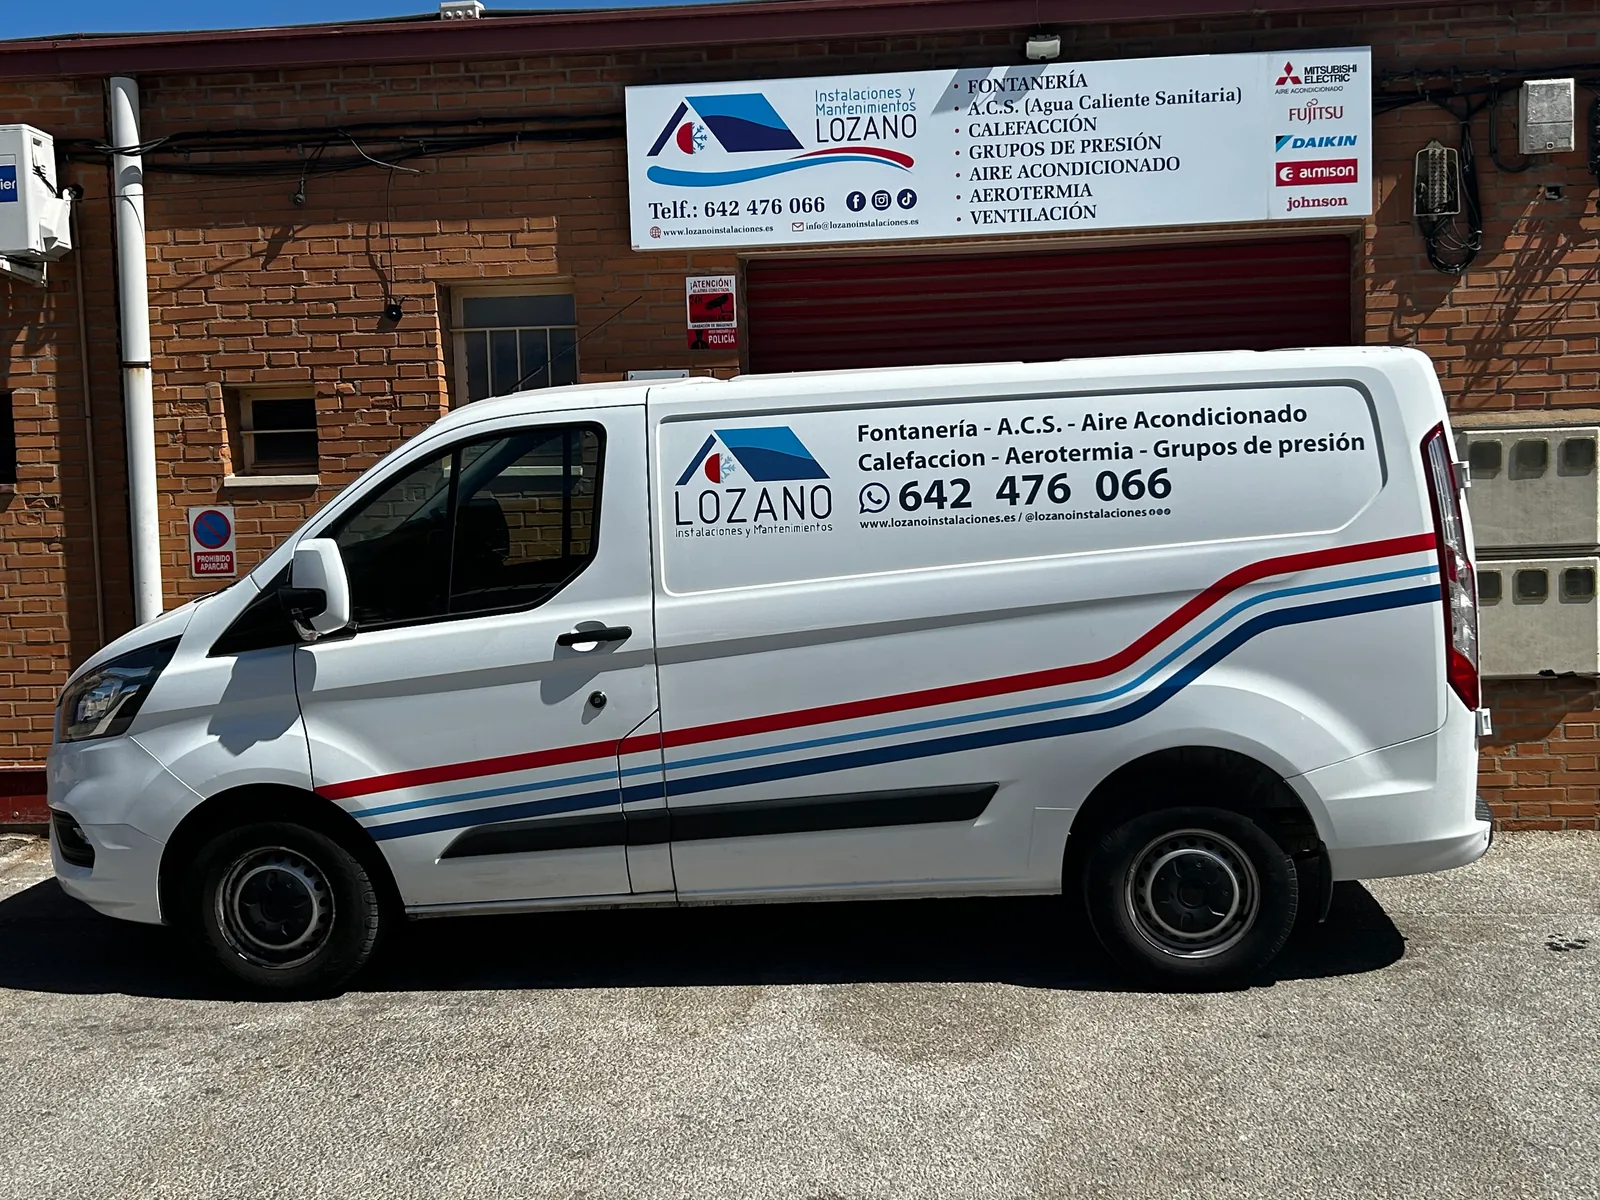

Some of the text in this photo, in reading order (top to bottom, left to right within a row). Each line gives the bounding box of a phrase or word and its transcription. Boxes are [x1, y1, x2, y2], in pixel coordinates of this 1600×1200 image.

[1304, 64, 1357, 75] MITSUBISHI
[967, 71, 1088, 94] FONTANERÍA
[1304, 74, 1350, 84] ELECTRIC
[814, 87, 916, 103] Instalaciones y
[1290, 86, 1344, 94] ACONDICIONADO
[815, 100, 917, 116] Mantenimientos
[967, 86, 1242, 117] A.C.S. (Agua Caliente Sanitaria)
[1288, 100, 1344, 124] FUJITSU
[816, 114, 917, 143] LOZANO
[968, 115, 1098, 138] CALEFACCIÓN
[969, 132, 1162, 160] GRUPOS DE PRESIÓN
[1291, 135, 1358, 149] DAIKIN
[969, 156, 1181, 182] AIRE ACONDICIONADO
[1299, 166, 1355, 178] almison
[969, 183, 1093, 204] AEROTERMIA
[648, 196, 825, 220] Telf.: 642 476 066
[1286, 196, 1348, 212] johnson
[970, 202, 1097, 225] VENTILACIÓN
[663, 225, 774, 237] www.lozanoinstalaciones.es
[805, 218, 919, 231] info@lozanoinstalaciones.es
[690, 278, 732, 290] ¡ATENCIÓN!
[708, 333, 735, 344] POLICÍA
[858, 420, 978, 442] Fontanería
[997, 415, 1062, 436] A.C.S.
[1081, 412, 1127, 432] Aire
[1134, 404, 1307, 429] Acondicionado
[858, 450, 986, 471] Calefaccion
[1005, 442, 1133, 465] Aerotermia
[1153, 440, 1238, 461] Grupos
[1243, 435, 1273, 455] de
[1279, 432, 1365, 458] presión
[899, 468, 1172, 511] 642 476 066
[674, 484, 832, 525] LOZANO
[859, 514, 1016, 529] www.lozanoinstalaciones.es
[1025, 507, 1147, 521] @lozanoinstalaciones
[675, 522, 833, 538] Instalaciones y Mantenimientos
[197, 555, 230, 563] PROHIBIDO
[200, 562, 228, 570] APARCAR
